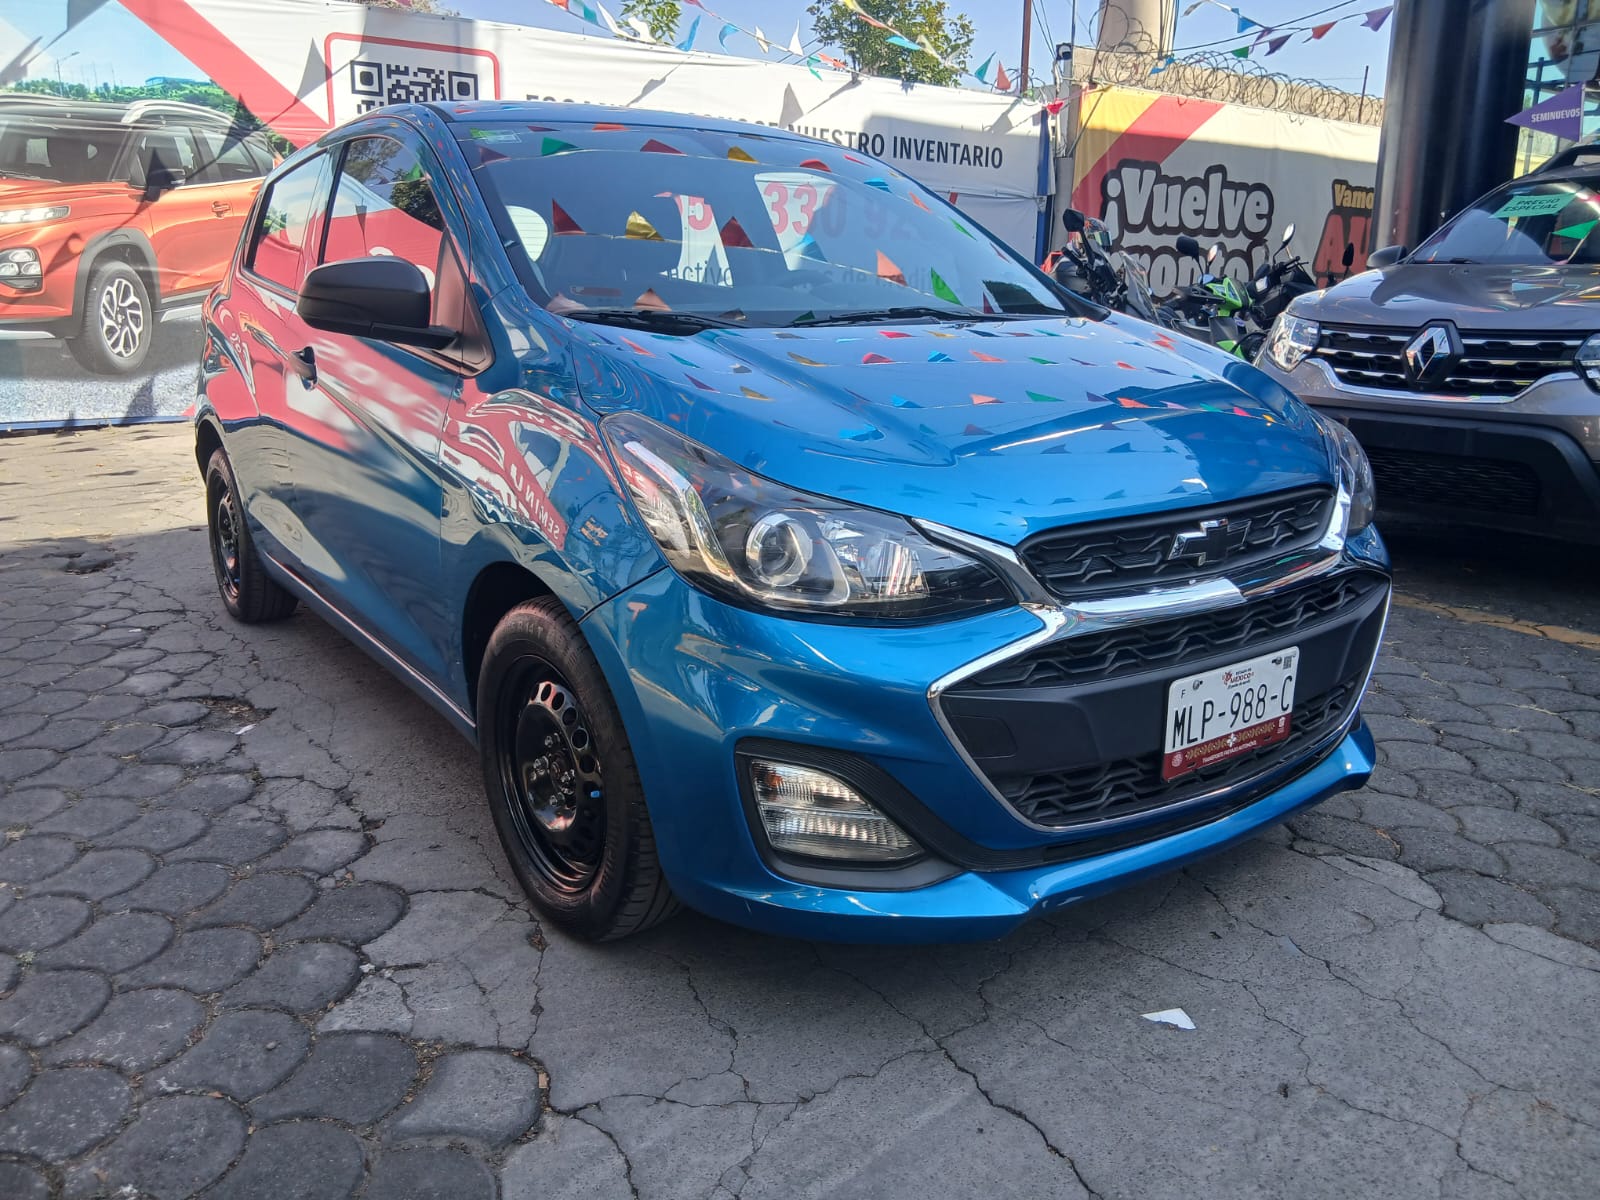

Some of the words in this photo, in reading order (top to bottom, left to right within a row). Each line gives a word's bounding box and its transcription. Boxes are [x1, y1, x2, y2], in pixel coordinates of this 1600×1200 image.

[1531, 108, 1581, 123] SEMINUEVOS
[893, 136, 1004, 169] INVENTARIO
[1104, 167, 1269, 241] ¡Vuelve
[1504, 203, 1559, 212] ESPECIAL
[1517, 198, 1560, 206] PRECIO
[1172, 675, 1293, 749] MLP-988-C
